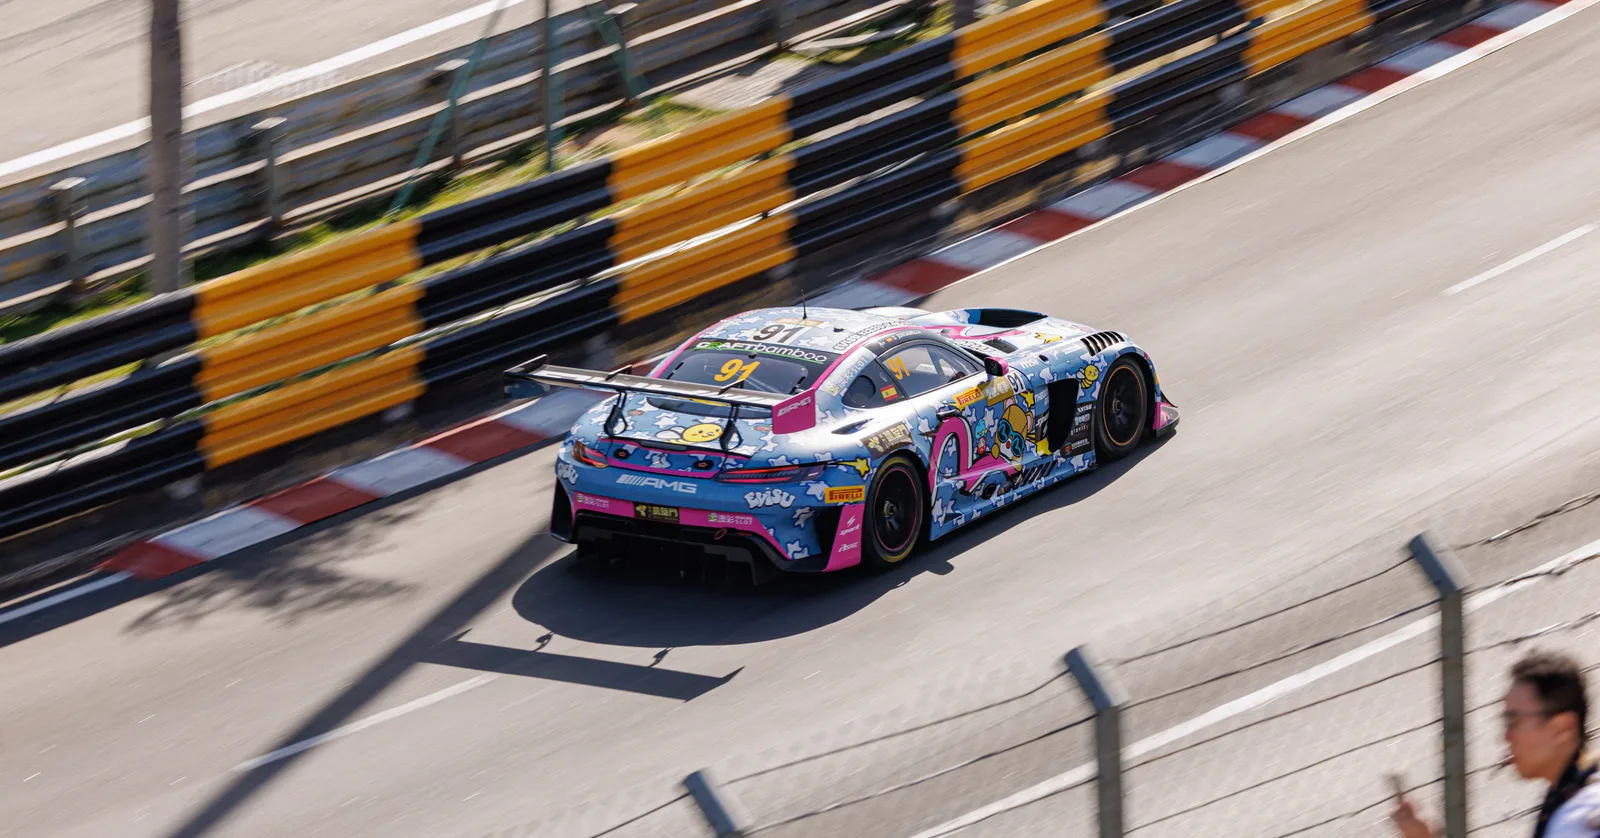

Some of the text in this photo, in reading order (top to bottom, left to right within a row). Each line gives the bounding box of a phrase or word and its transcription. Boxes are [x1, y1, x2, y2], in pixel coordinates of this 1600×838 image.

[753, 324, 805, 344] 91
[714, 359, 760, 382] 91
[887, 354, 911, 380] 91
[1007, 372, 1024, 392] 91
[957, 387, 983, 406] PIRELLI
[640, 476, 698, 494] AMG
[829, 488, 863, 501] PIRELLI
